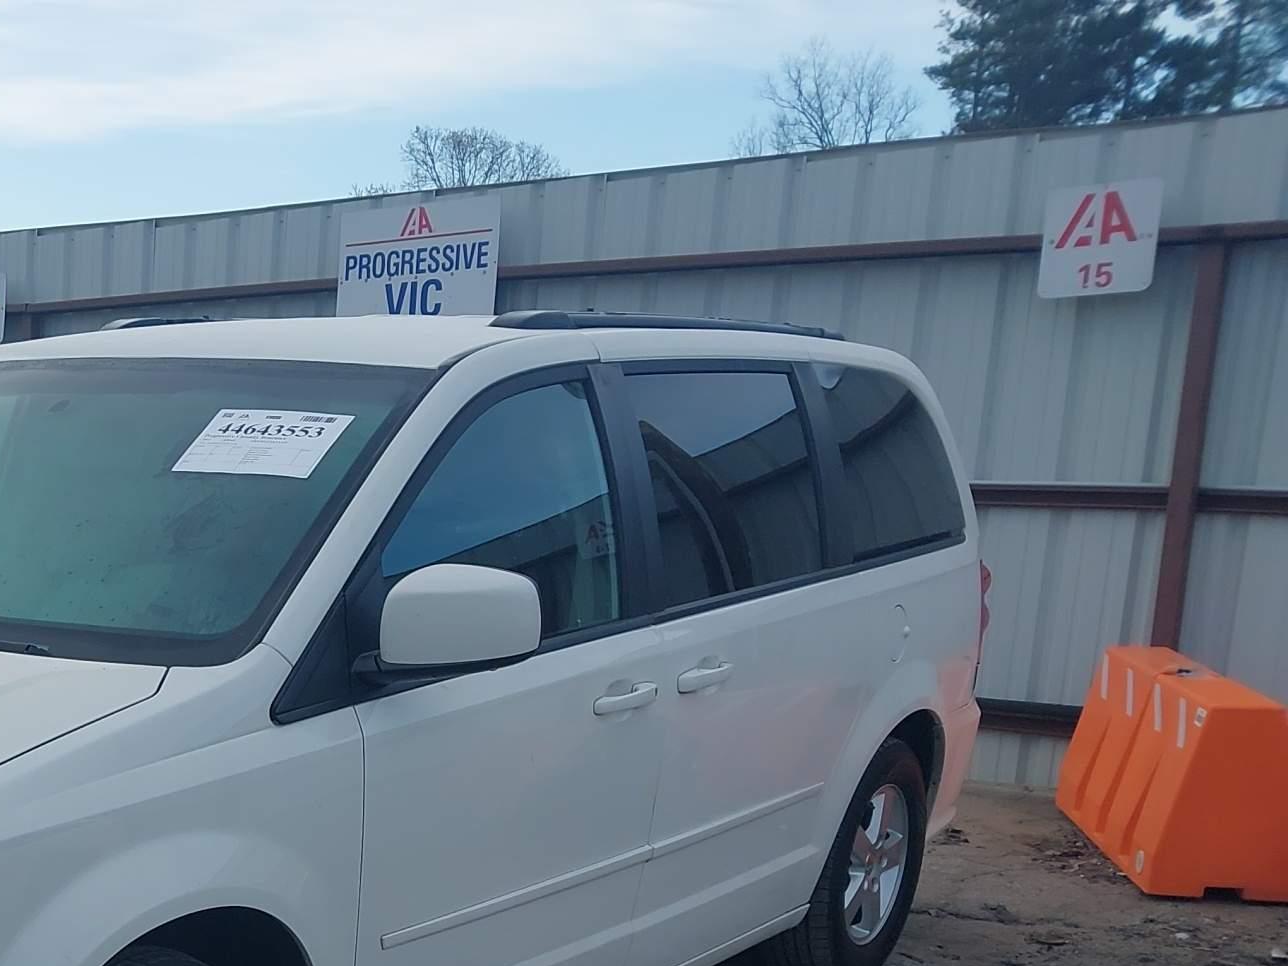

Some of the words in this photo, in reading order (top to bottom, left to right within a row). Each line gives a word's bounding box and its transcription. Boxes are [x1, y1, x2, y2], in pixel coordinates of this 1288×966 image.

[344, 241, 490, 281] PROGRESSIVE
[1078, 262, 1114, 288] 15
[385, 279, 443, 316] VIC
[217, 422, 326, 438] 44643553
